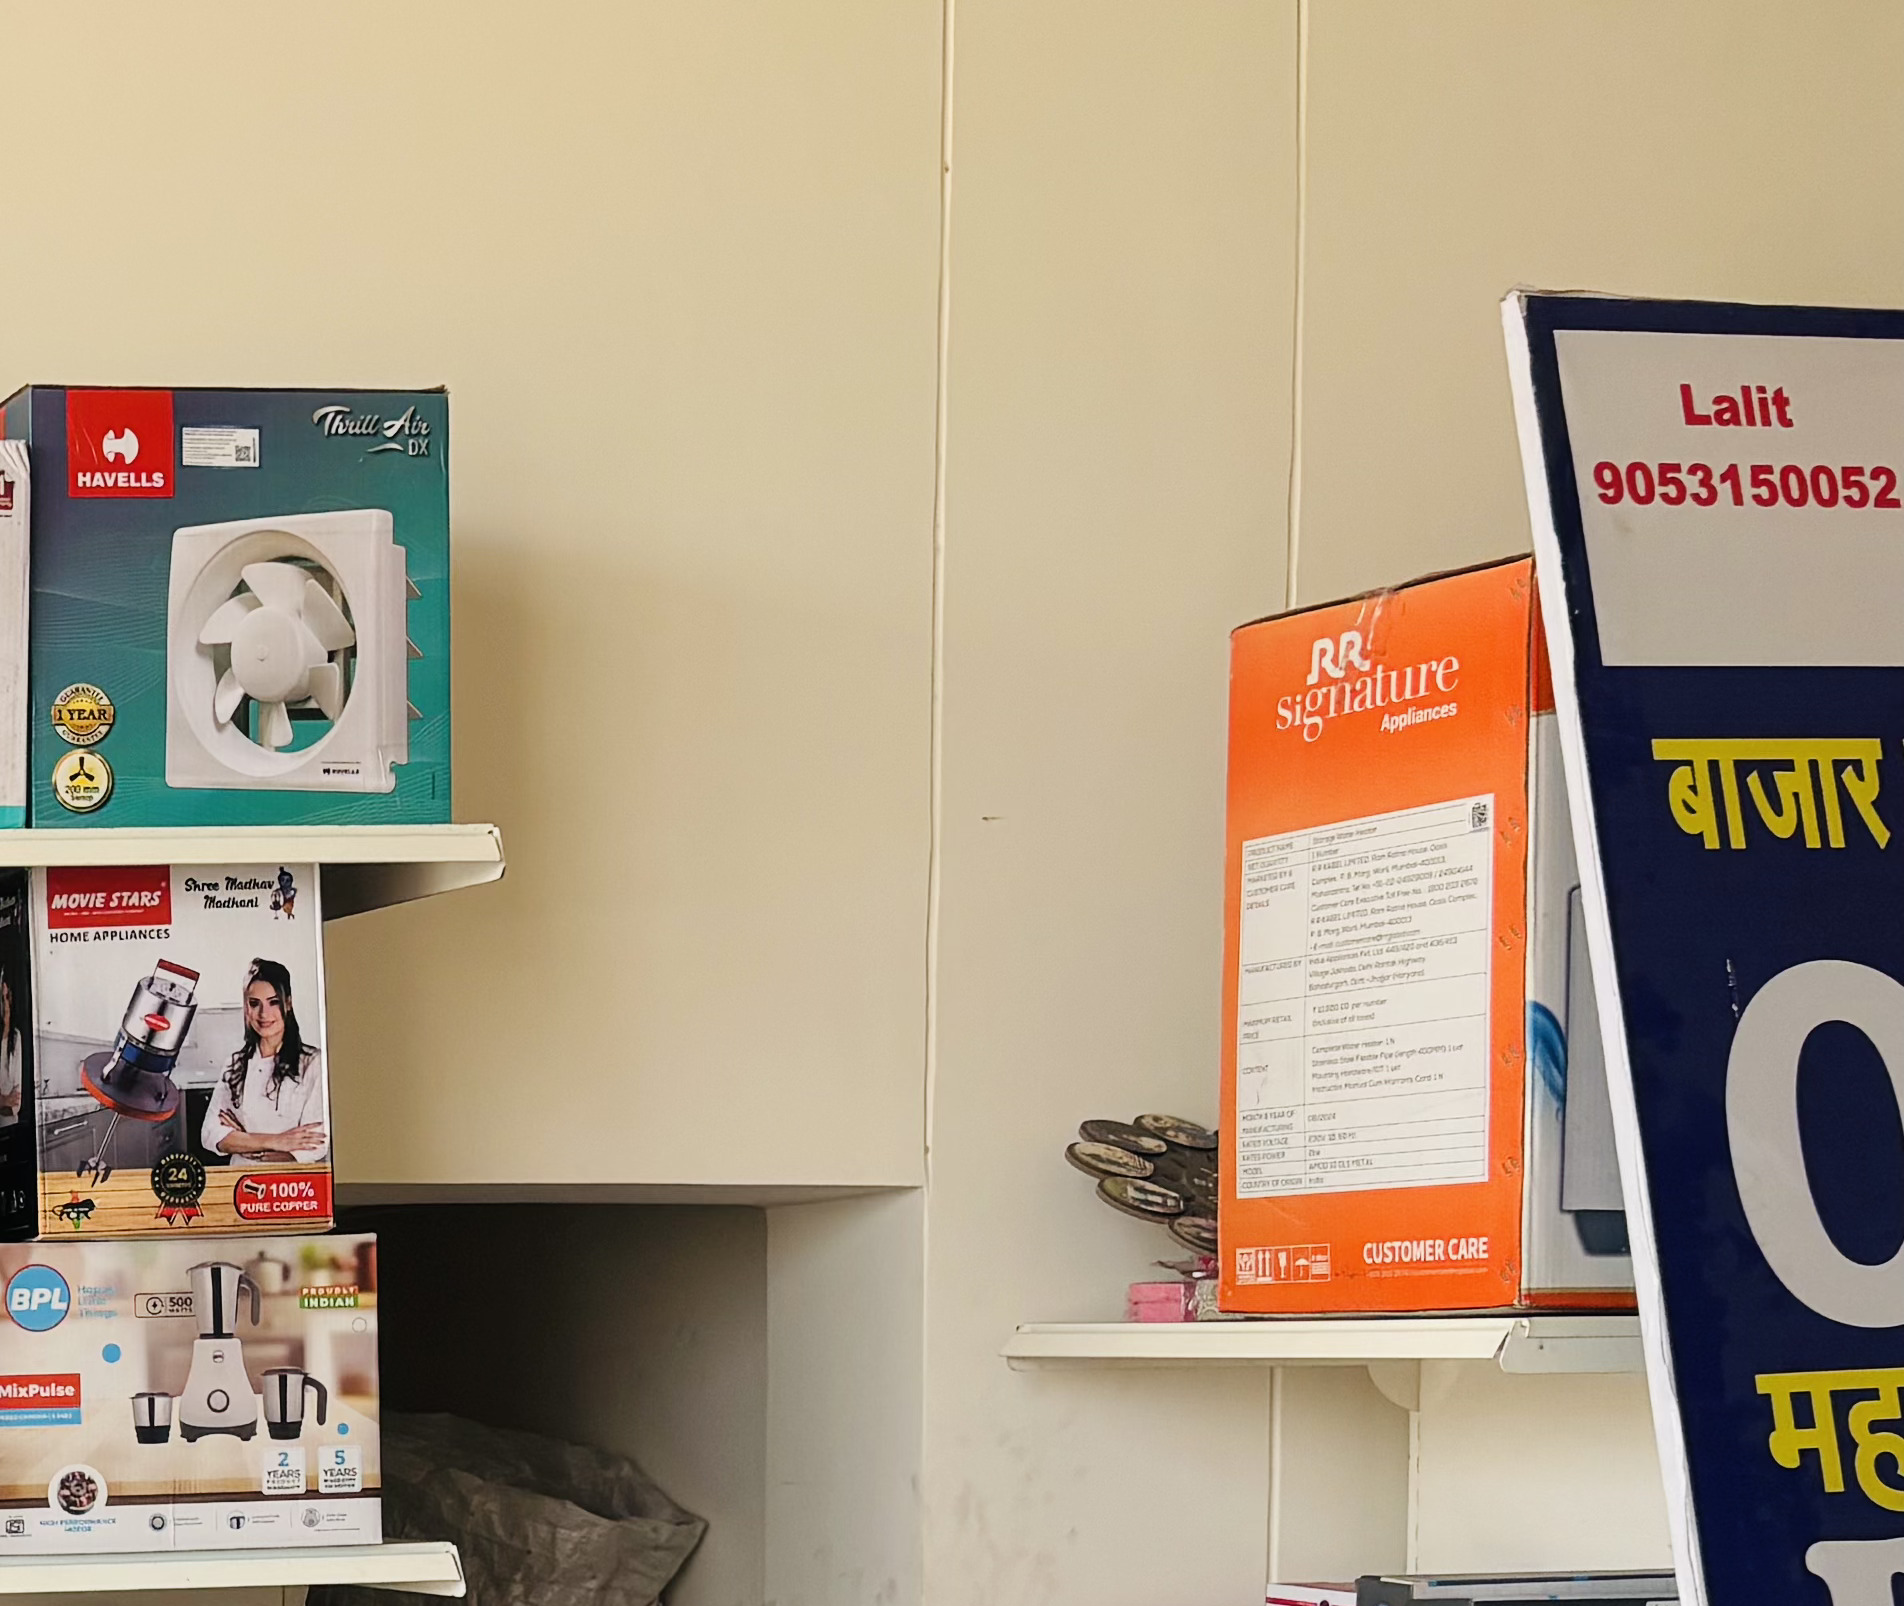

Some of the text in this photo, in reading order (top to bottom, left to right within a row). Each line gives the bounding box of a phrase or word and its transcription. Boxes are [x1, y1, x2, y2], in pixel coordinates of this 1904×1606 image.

[1680, 384, 1794, 428] Lalit
[313, 405, 430, 437] Thrill Air
[408, 440, 428, 455] DX
[77, 473, 164, 488] HAVELLS
[1594, 461, 1902, 508] 9053150052
[1275, 654, 1459, 743] signature
[69, 709, 108, 721] YEAR
[1380, 701, 1457, 733] Appliances
[1651, 738, 1890, 850] बाजार
[185, 878, 219, 892] Shree
[52, 891, 161, 909] MOVIE STARS
[50, 929, 170, 943] HOME APPLIANCES
[270, 1182, 314, 1197] 100%
[240, 1200, 317, 1213] PURE COPPER
[1363, 1237, 1489, 1265] CUSTOMER CARE
